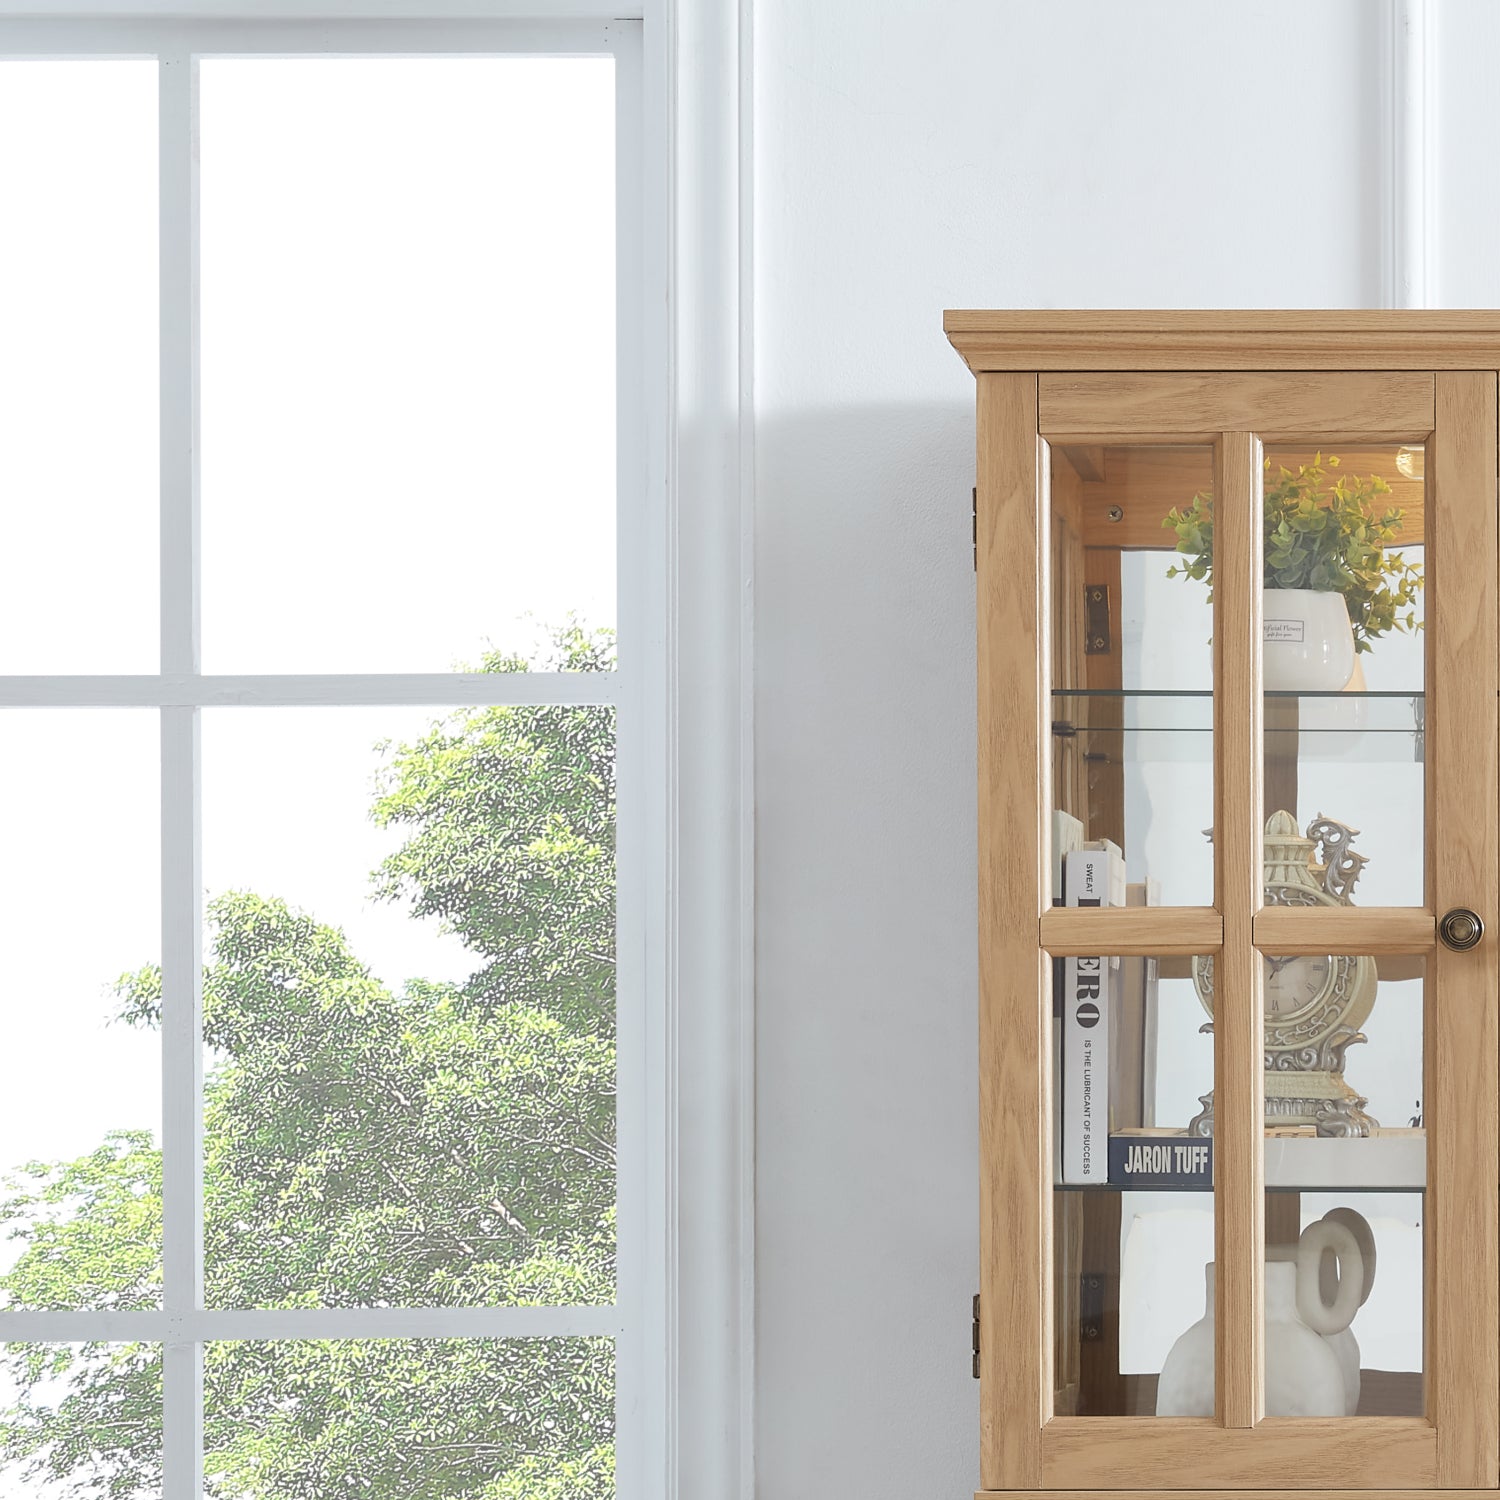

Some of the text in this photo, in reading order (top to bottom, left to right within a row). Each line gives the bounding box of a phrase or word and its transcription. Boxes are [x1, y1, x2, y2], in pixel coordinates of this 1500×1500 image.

[1086, 863, 1094, 894] SWEAT
[1083, 1040, 1092, 1175] IS THE LUBRICANT OF SUCCESS
[1124, 1145, 1209, 1174] JARON TUFF
